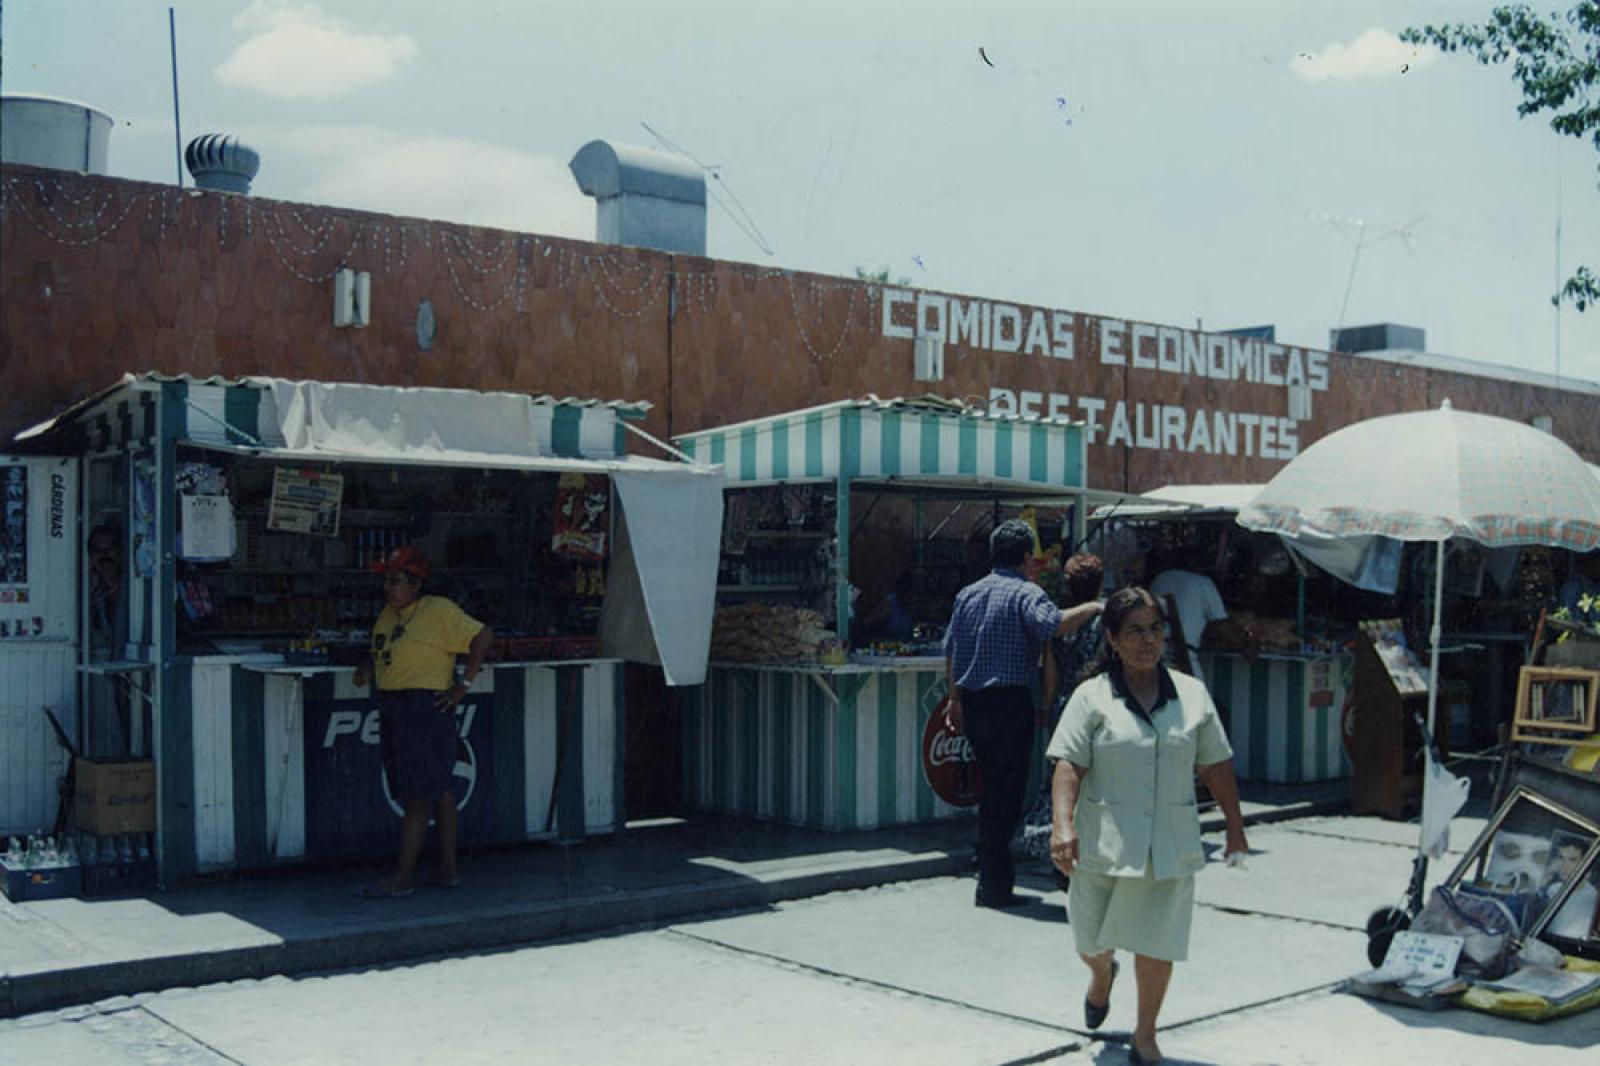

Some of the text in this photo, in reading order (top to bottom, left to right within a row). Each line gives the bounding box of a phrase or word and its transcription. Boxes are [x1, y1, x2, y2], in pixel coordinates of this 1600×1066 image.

[882, 288, 1329, 391] COMIDAS ECONOMICAS
[322, 703, 477, 748] PEI
